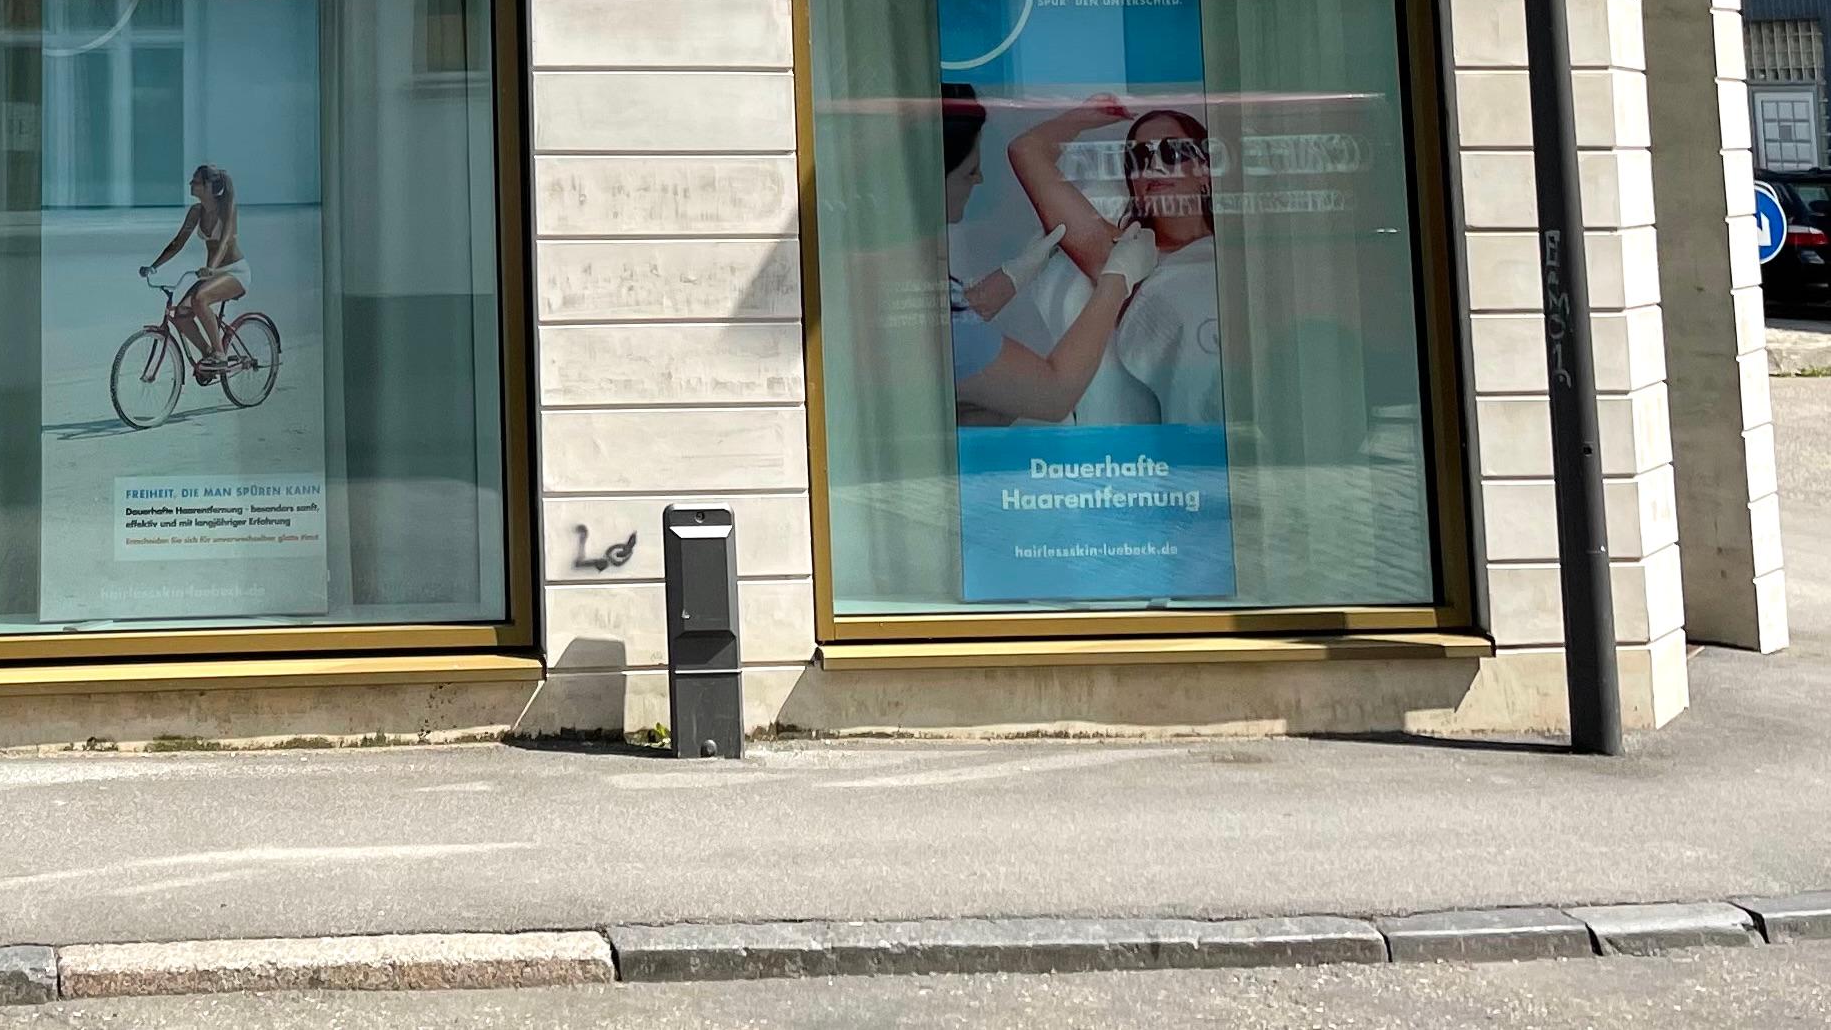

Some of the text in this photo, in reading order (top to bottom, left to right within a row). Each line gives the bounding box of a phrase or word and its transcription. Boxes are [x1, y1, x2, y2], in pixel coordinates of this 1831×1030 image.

[1029, 455, 1169, 479] Dauerhafte
[182, 488, 199, 498] DIE
[204, 487, 231, 497] MAN
[236, 484, 280, 496] SPÜREN
[286, 484, 321, 495] KANN
[1001, 485, 1200, 512] Haarentfernung
[126, 506, 173, 516] Dauerhafte
[176, 505, 243, 516] Haarentfernung
[160, 519, 176, 527] und
[179, 519, 192, 527] mit
[249, 516, 290, 527] Erfahrung
[1015, 541, 1178, 558] hairlessskin-luebeck.de
